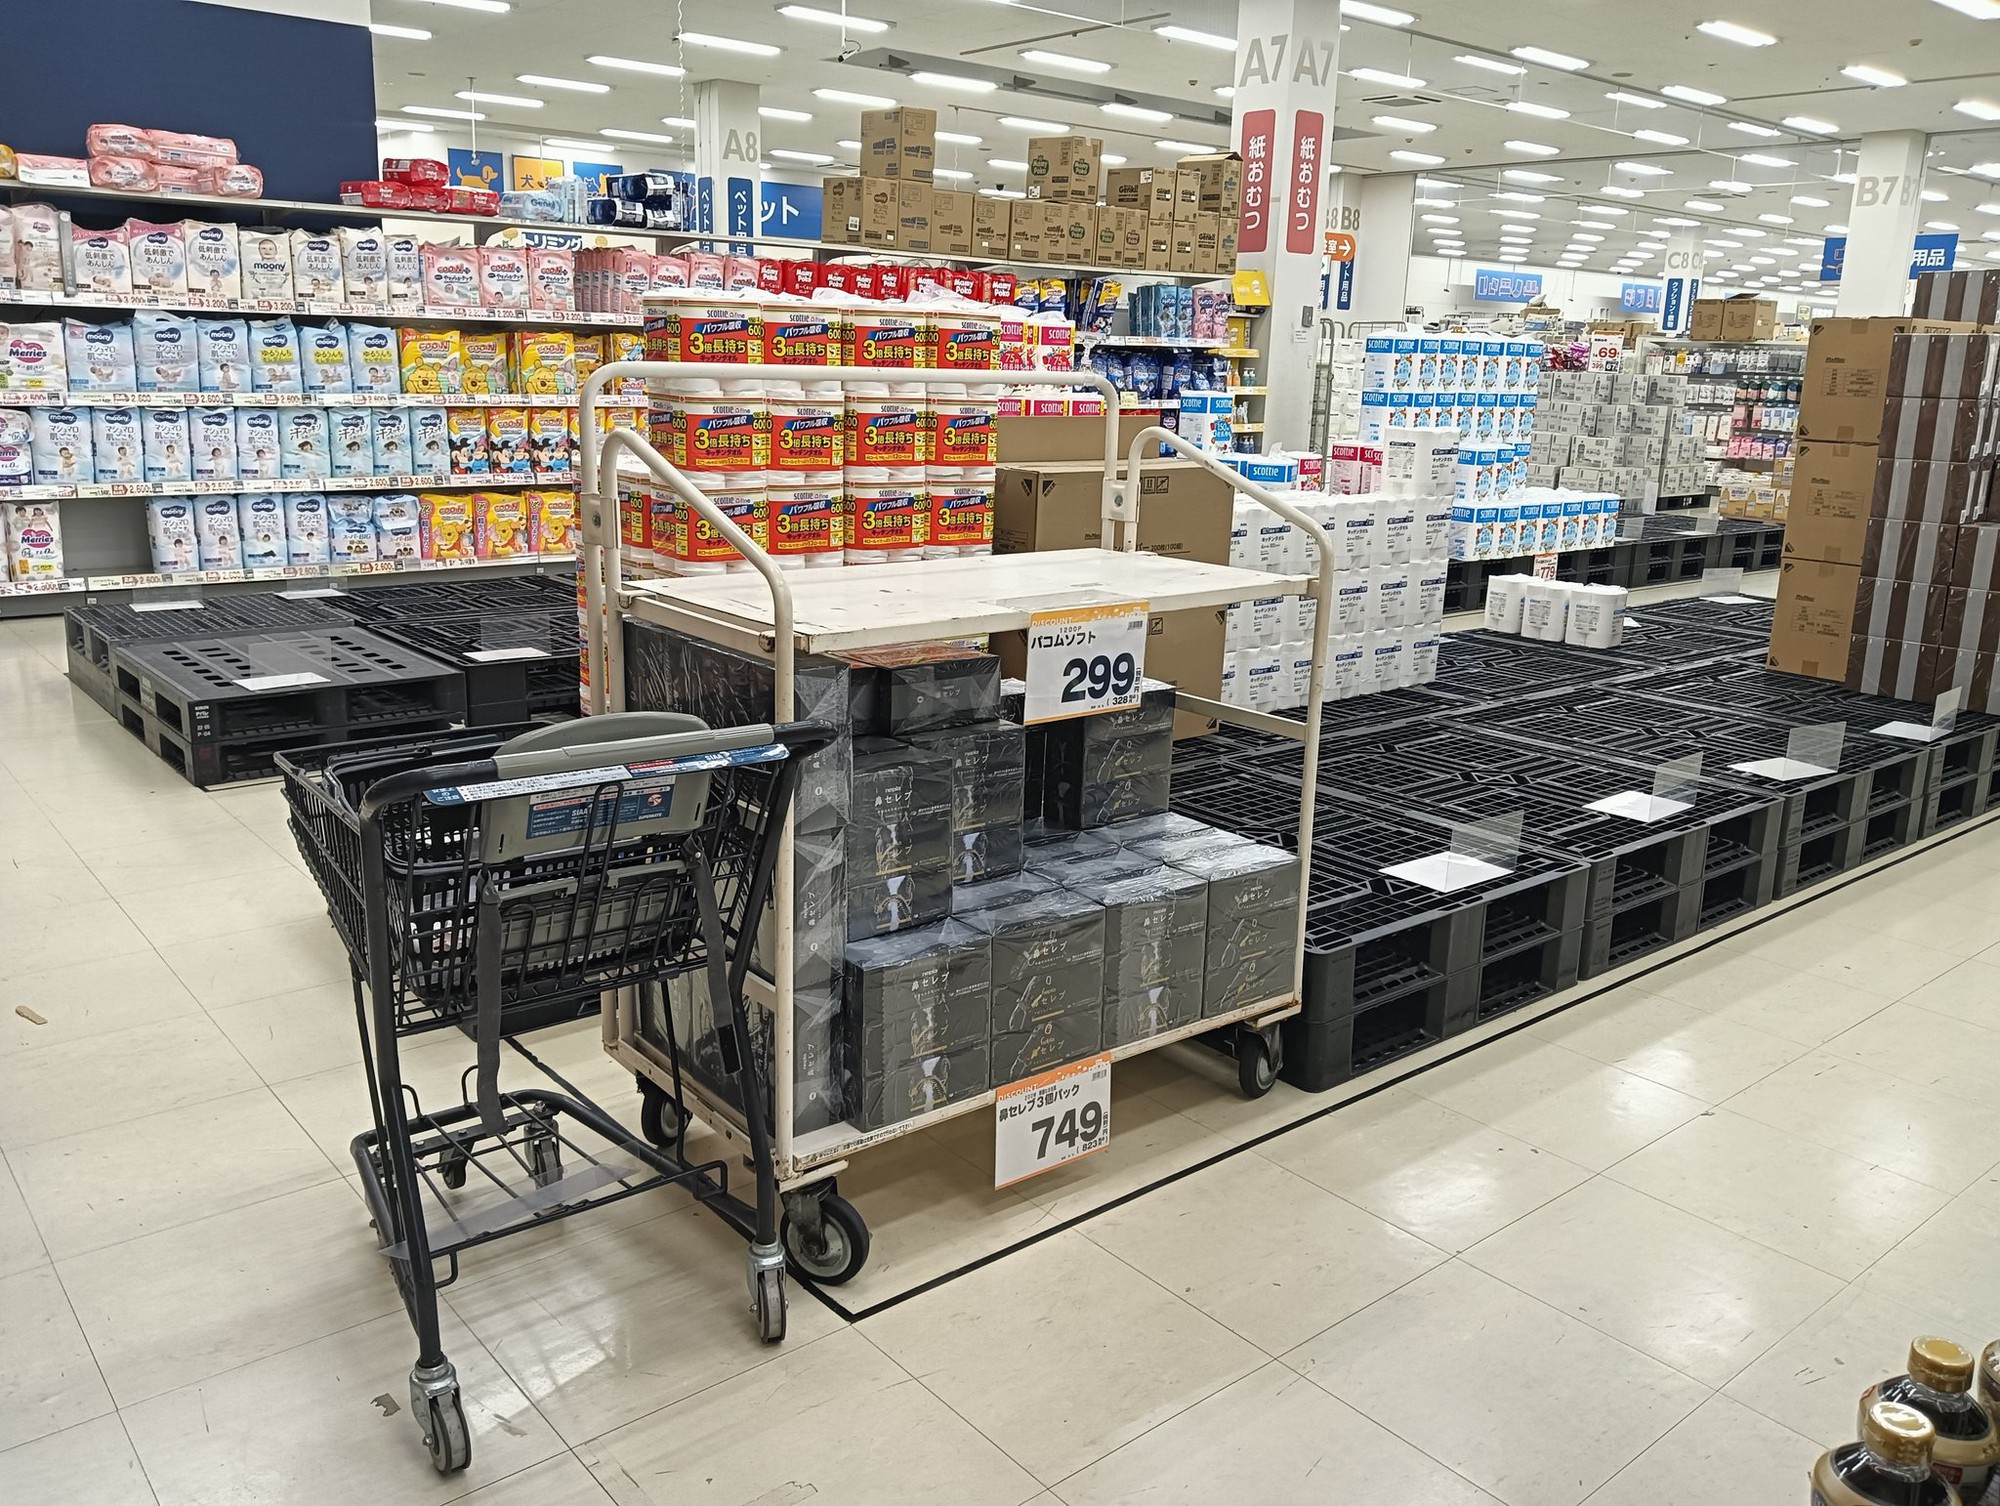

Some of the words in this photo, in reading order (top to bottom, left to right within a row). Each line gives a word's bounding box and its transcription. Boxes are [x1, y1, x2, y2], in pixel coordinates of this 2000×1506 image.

[1239, 34, 1289, 87] A7
[1293, 38, 1335, 87] A7
[723, 129, 757, 162] A8
[1244, 134, 1267, 231] 紙おむつ
[1295, 136, 1316, 231] 紙おむつ
[1856, 176, 1900, 207] B7
[1341, 206, 1360, 231] B8
[200, 229, 222, 241] moony
[1668, 251, 1689, 269] C8
[1913, 248, 1946, 266] 用品
[253, 262, 285, 271] moony
[86, 332, 112, 341] moony
[155, 332, 180, 340] moony
[210, 331, 234, 339] moony
[263, 337, 286, 346] moony
[1048, 328, 1070, 339] scottie
[315, 338, 338, 347] moony
[365, 338, 387, 347] moony
[689, 333, 746, 354] 3倍長持ち
[772, 336, 825, 357] 3倍長持ち
[862, 339, 912, 360] 3倍長持ち
[1367, 339, 1390, 349] scottie
[9, 348, 47, 358] Merries
[945, 341, 990, 362] 3倍長持ち
[1598, 347, 1618, 359] 69
[1363, 392, 1385, 402] scottie
[998, 401, 1020, 413] scottie
[1041, 402, 1063, 413] scottie
[1078, 402, 1101, 414] scottie
[50, 413, 75, 422] moony
[694, 428, 751, 450] 3倍長持ち
[779, 429, 831, 449] 3倍長持ち
[864, 427, 913, 446] 3倍長持ち
[943, 427, 988, 446] 3倍長持ち
[1333, 446, 1355, 457] scottie
[1253, 467, 1279, 477] scottie
[776, 514, 829, 534] 3倍長持ち
[21, 535, 54, 544] Merries
[1540, 565, 1556, 579] 779
[1031, 631, 1096, 649] パコムソフト
[1061, 652, 1135, 703] 299
[1112, 696, 1128, 705] 328
[874, 790, 912, 807] 鼻セレブ
[1143, 911, 1175, 927] 鼻セレブ
[911, 971, 950, 991] 鼻セレブ
[998, 1084, 1080, 1122] 鼻セレブ3個パック
[1031, 1101, 1102, 1160] 749
[1082, 1142, 1098, 1152] 823
